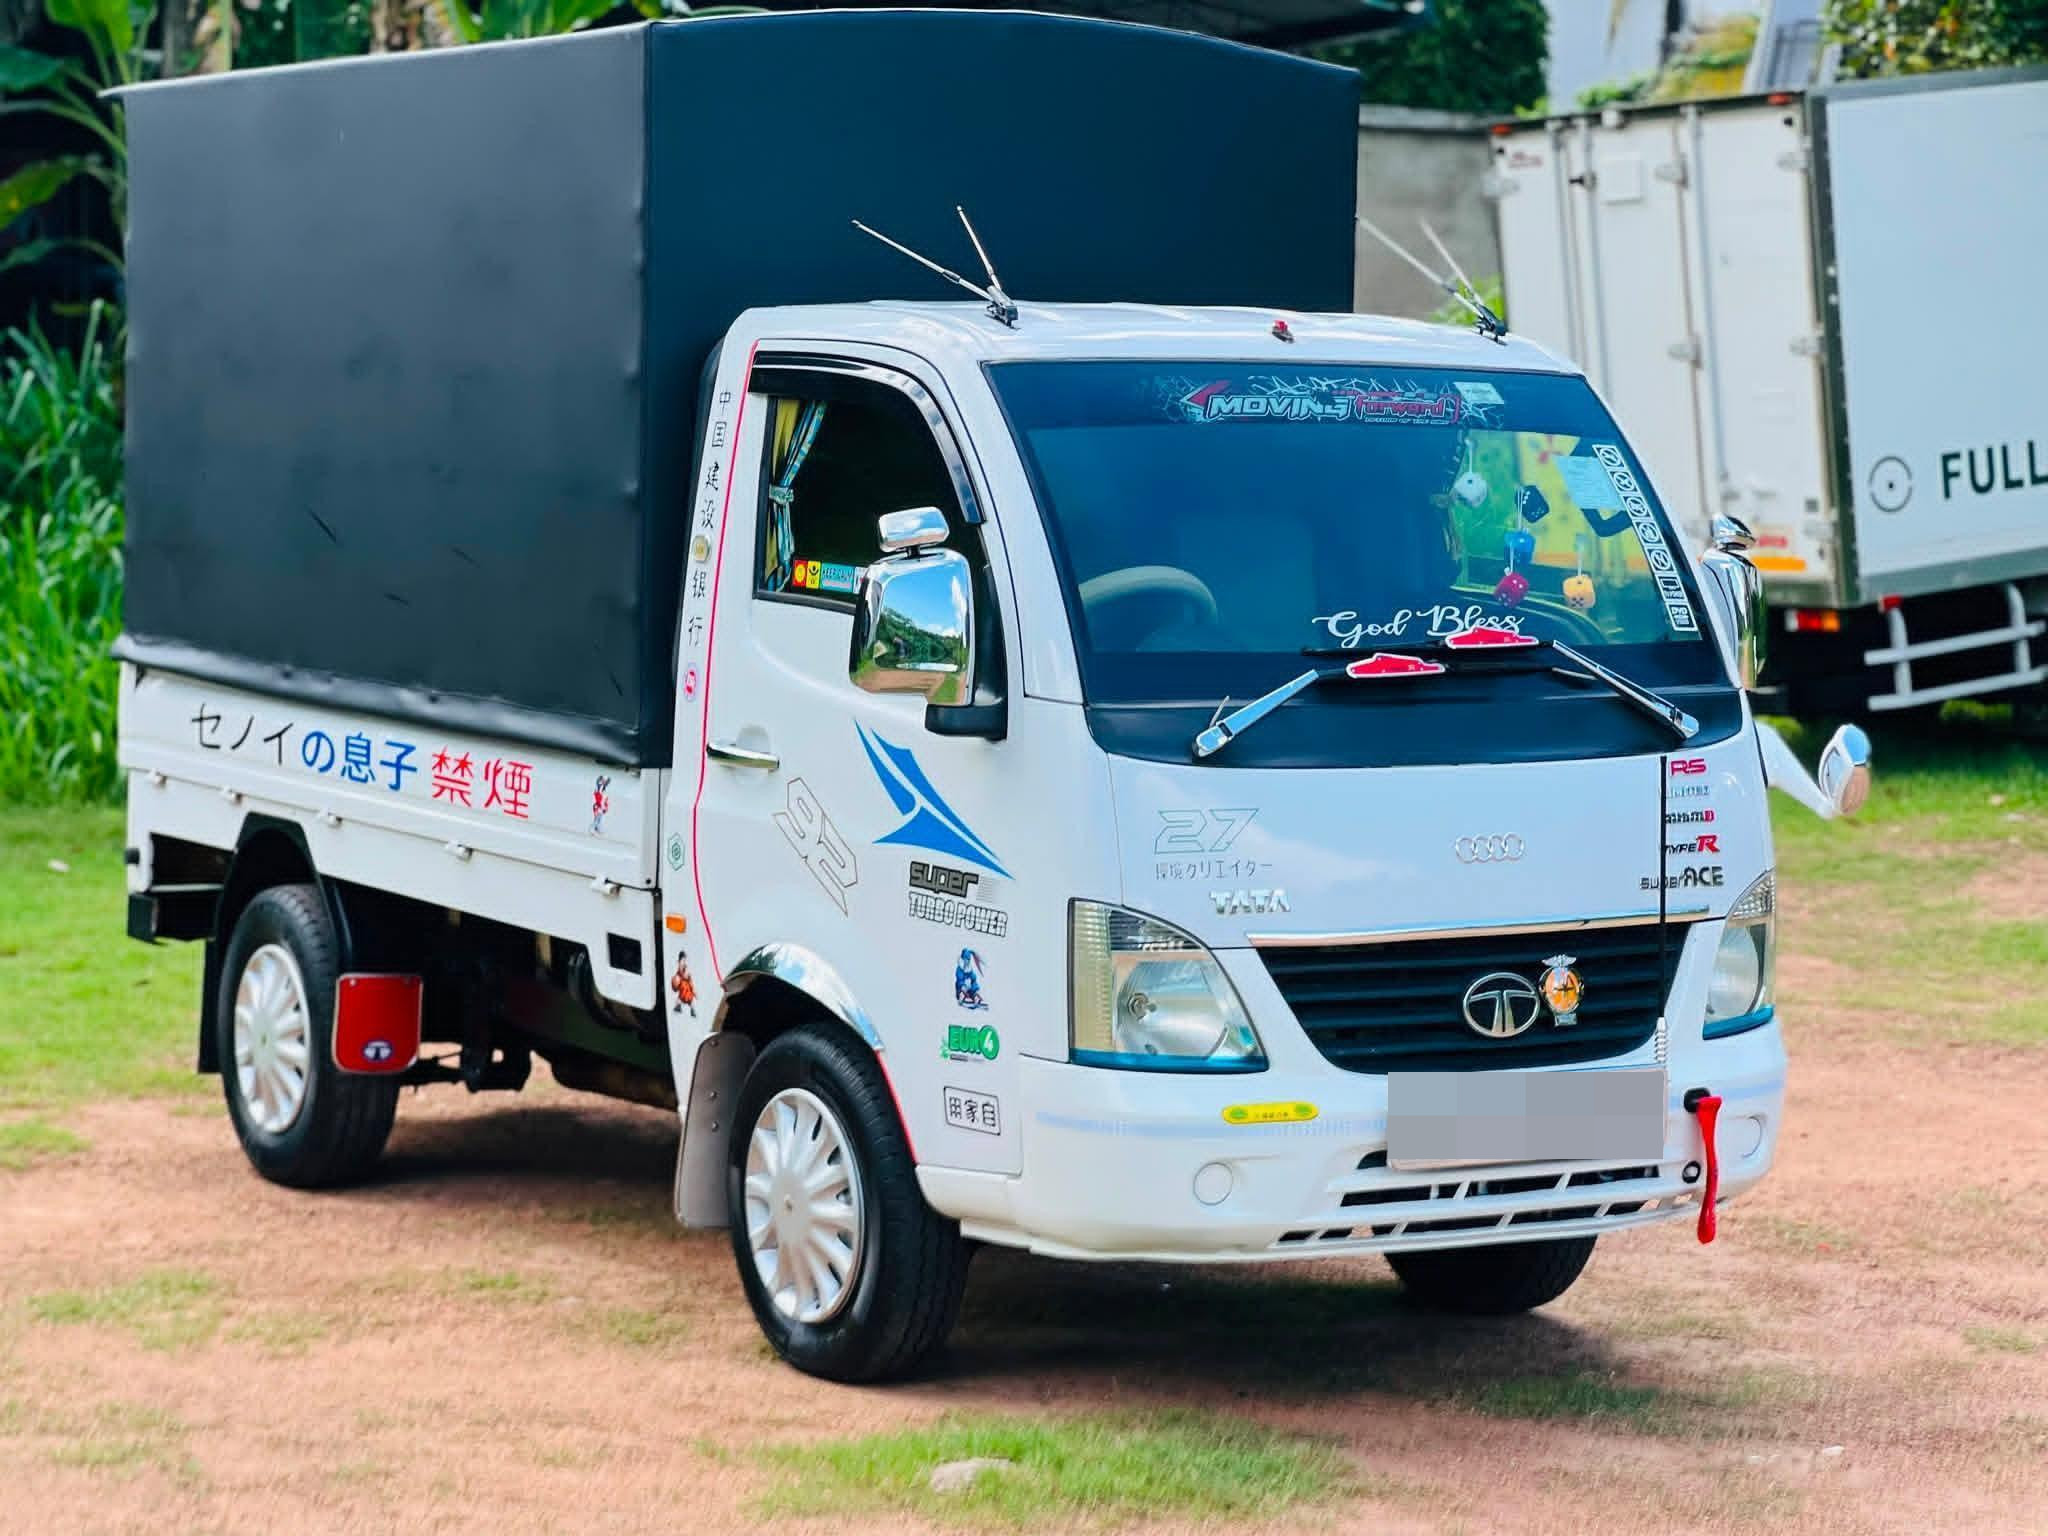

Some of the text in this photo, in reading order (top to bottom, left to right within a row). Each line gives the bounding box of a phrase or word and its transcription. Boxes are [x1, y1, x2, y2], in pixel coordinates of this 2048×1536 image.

[1941, 440, 2048, 500] FULL
[1312, 605, 1525, 648] God Bless
[431, 745, 534, 819] 禁煙
[1670, 759, 1706, 776] RS
[1154, 808, 1260, 855] 27
[909, 891, 1009, 937] TURBO POWER
[1209, 888, 1292, 915] TATA
